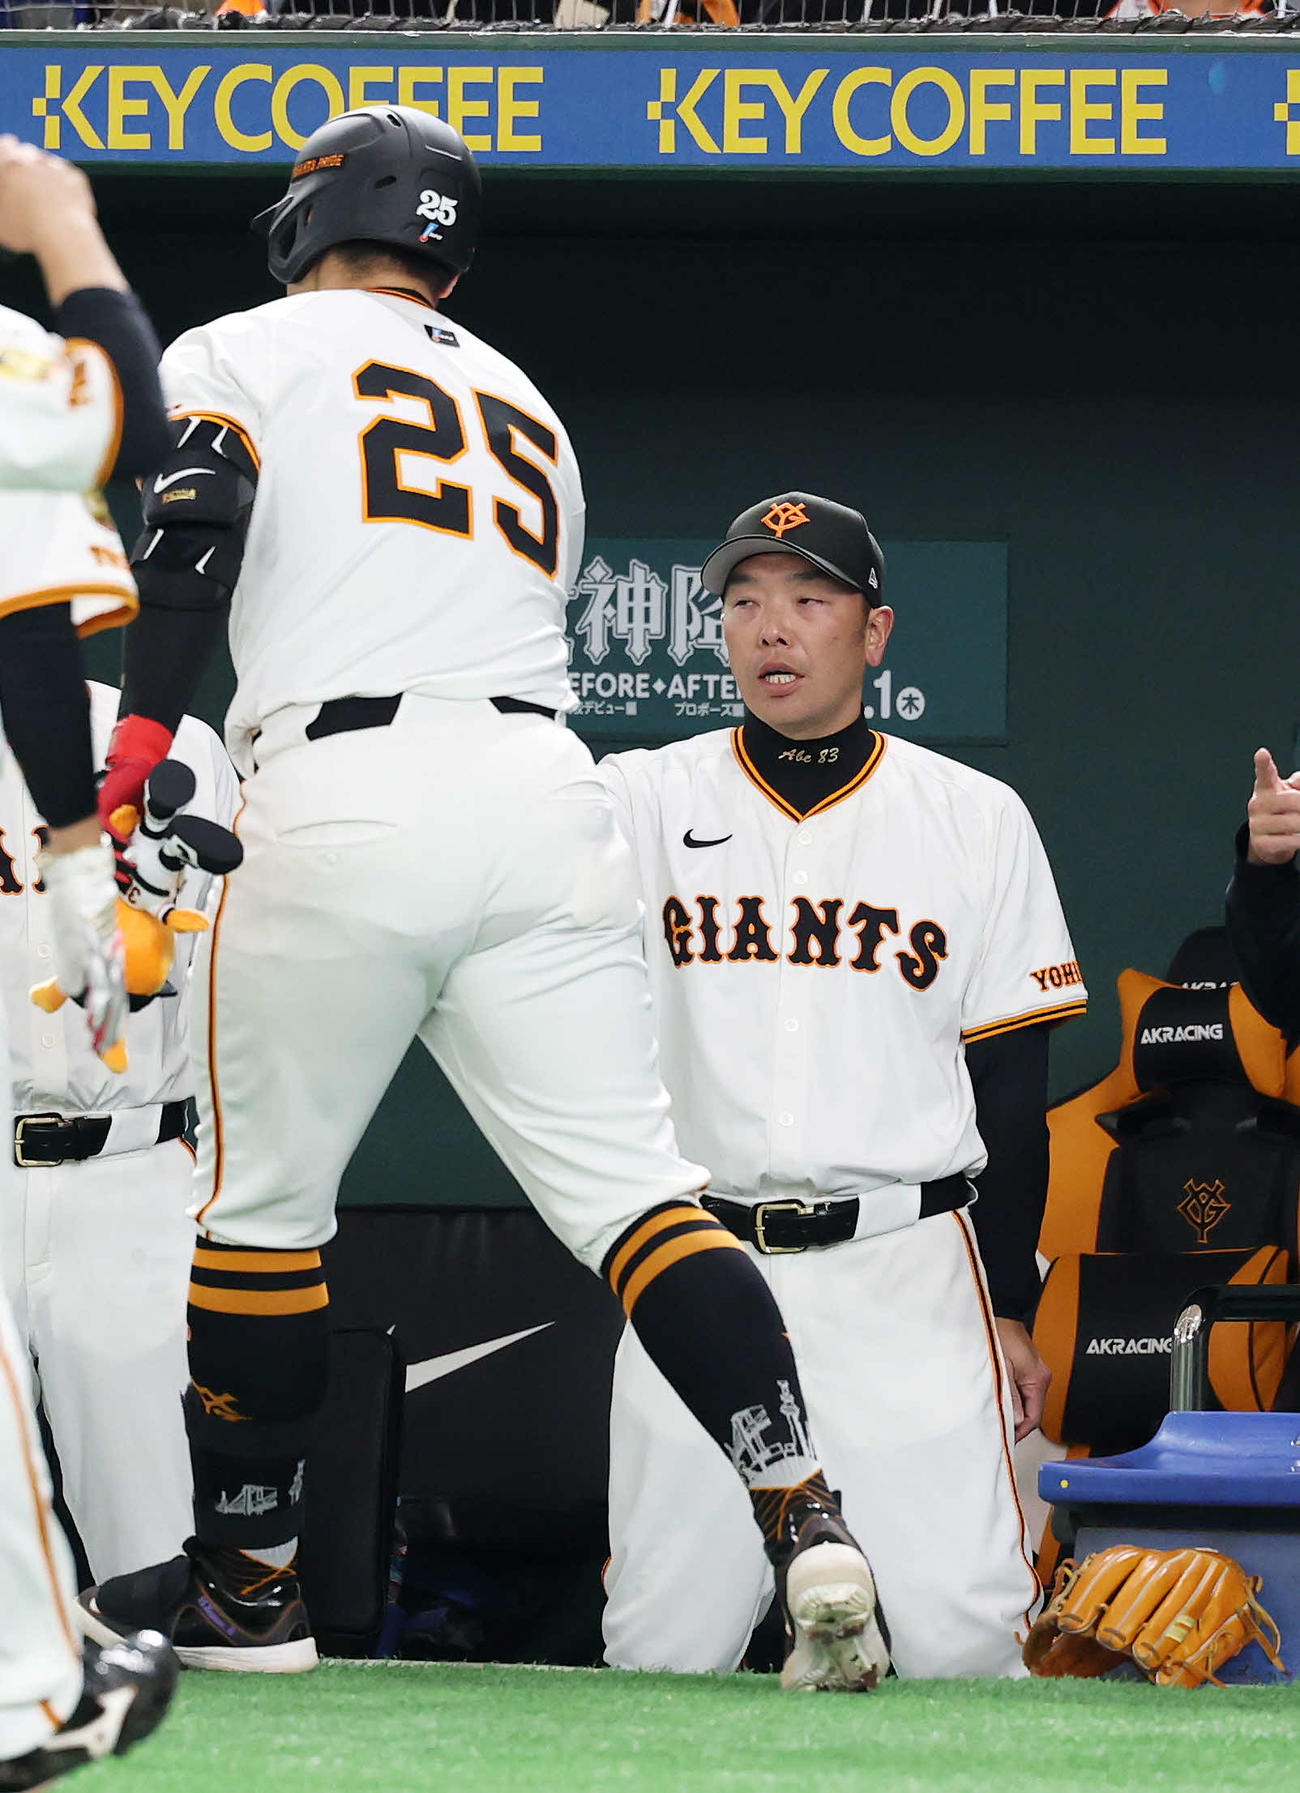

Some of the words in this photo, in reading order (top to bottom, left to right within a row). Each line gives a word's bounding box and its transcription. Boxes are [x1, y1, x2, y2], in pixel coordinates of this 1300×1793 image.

[416, 189, 458, 227] 25
[352, 359, 560, 581] 25
[568, 672, 650, 699] EFORE
[778, 748, 812, 763] Abe
[817, 747, 840, 764] 83
[662, 896, 949, 991] GIANTS
[1140, 1023, 1224, 1045] AKRACING
